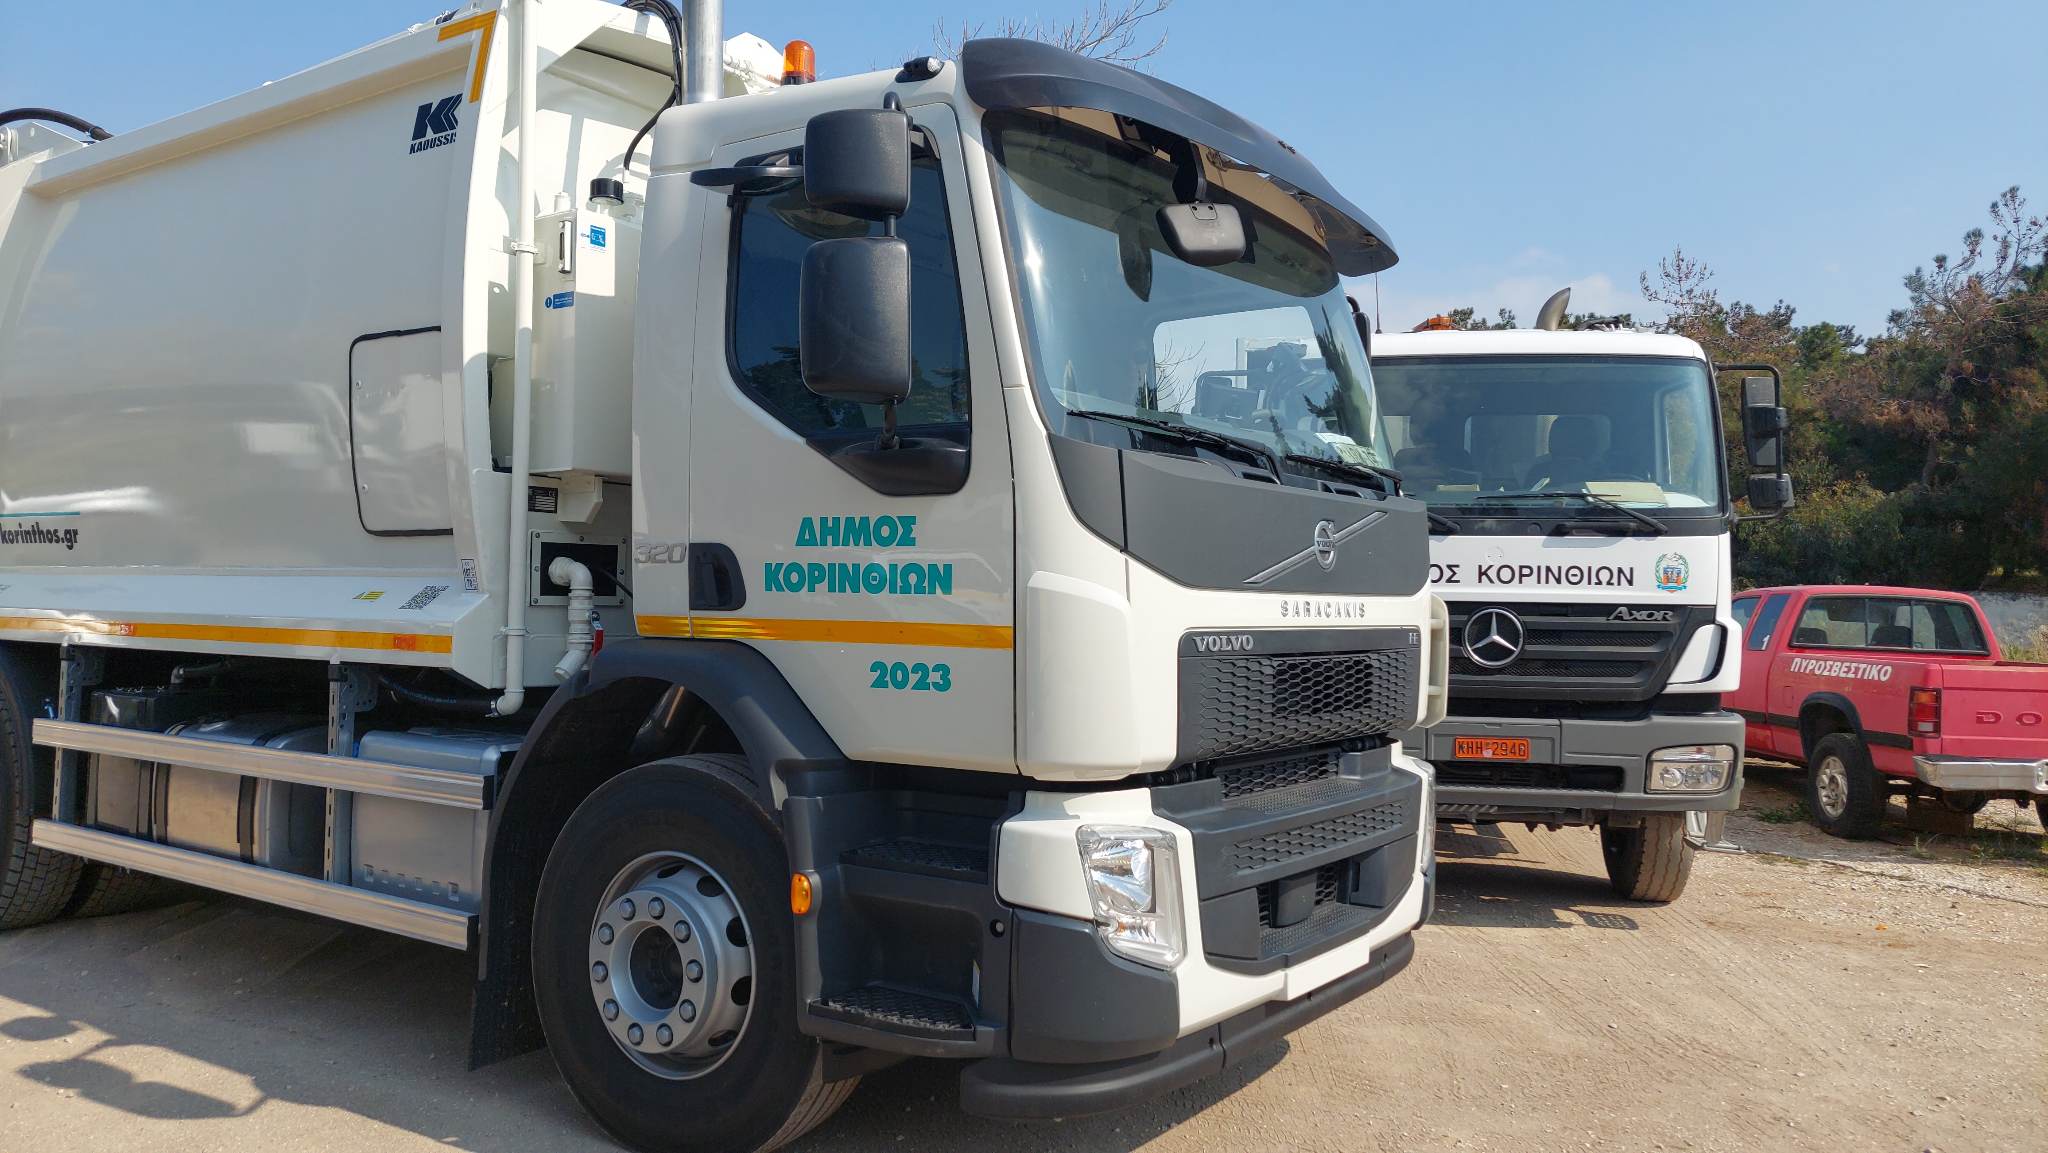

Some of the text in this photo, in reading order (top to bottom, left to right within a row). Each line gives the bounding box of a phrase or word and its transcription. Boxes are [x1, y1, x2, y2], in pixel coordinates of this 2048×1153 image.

[795, 514, 917, 547] ΔΗΜΟΣ
[634, 543, 687, 564] 320
[764, 561, 953, 595] ΚΟΡΙΝΘΙΩΝ
[1477, 564, 1634, 587] ΚΟΡΙΝΘΙΩΝ
[1280, 600, 1366, 618] SARACAKIS
[1192, 634, 1254, 652] VOLVO
[869, 660, 952, 692] 2023
[1790, 657, 1892, 682] ΠΥΡΟΣΒΕΣΤΙΚΟ
